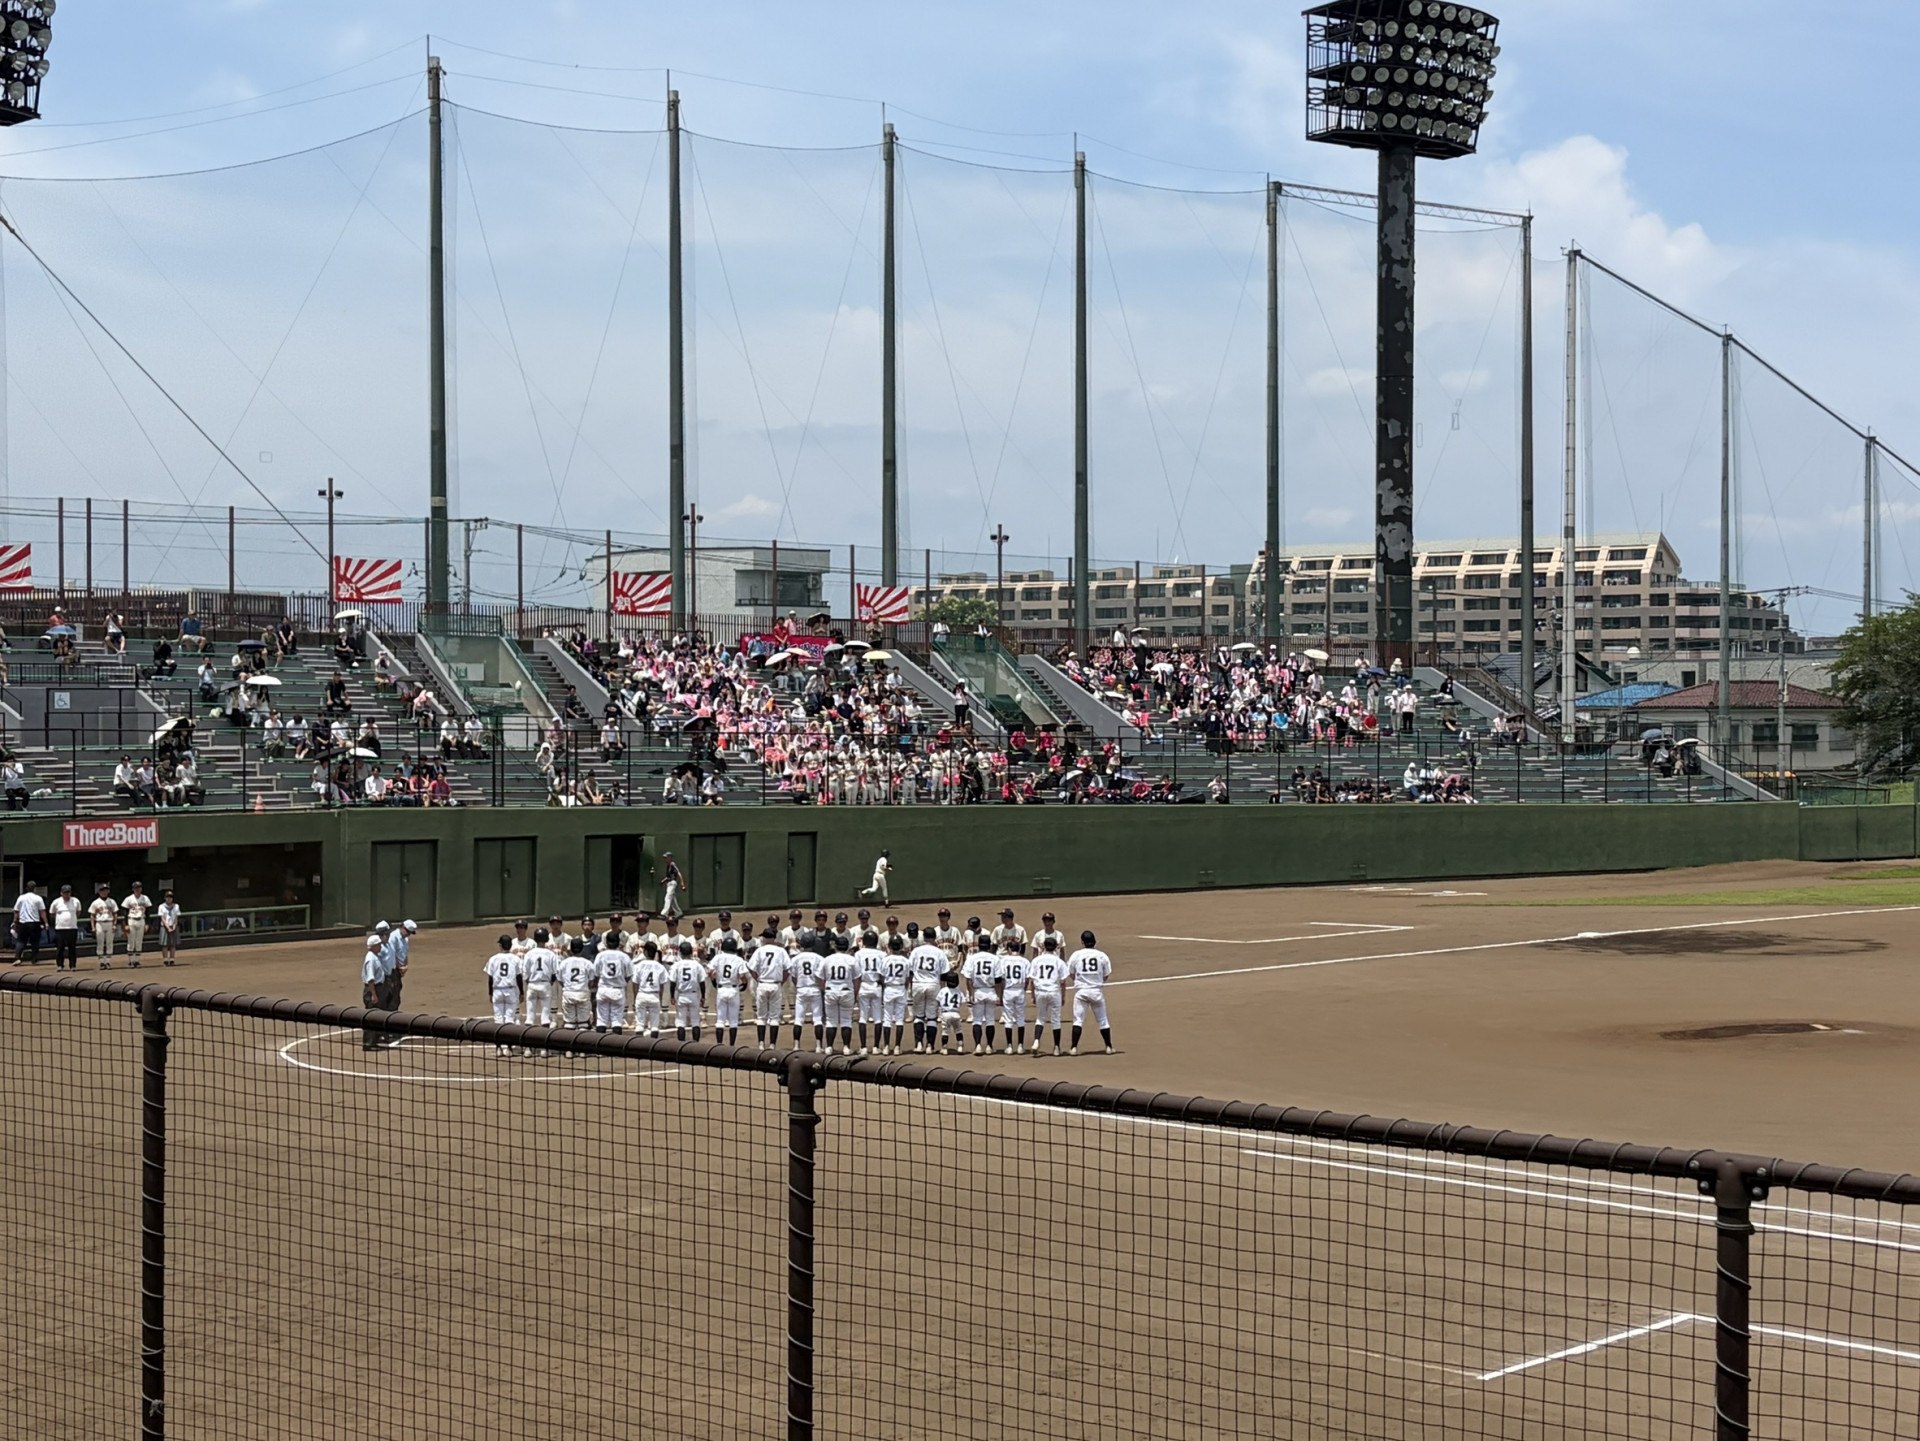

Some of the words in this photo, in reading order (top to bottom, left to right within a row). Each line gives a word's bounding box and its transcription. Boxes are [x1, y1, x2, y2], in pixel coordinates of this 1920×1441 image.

[66, 822, 157, 847] ThreeBond
[535, 957, 544, 972] 1
[765, 951, 775, 966] 7
[864, 957, 878, 972] 11
[918, 955, 935, 972] 13
[1081, 957, 1099, 973] 19
[499, 962, 509, 977] 9
[569, 967, 581, 983] 2
[606, 962, 617, 977] 3
[682, 967, 692, 983] 5
[722, 964, 733, 980] 6
[802, 961, 813, 976] 8
[829, 965, 845, 981] 10
[887, 963, 904, 979] 12
[975, 960, 992, 976] 15
[1005, 964, 1022, 980] 16
[1039, 964, 1055, 980] 17
[645, 971, 655, 987] 4
[942, 992, 959, 1009] 14
